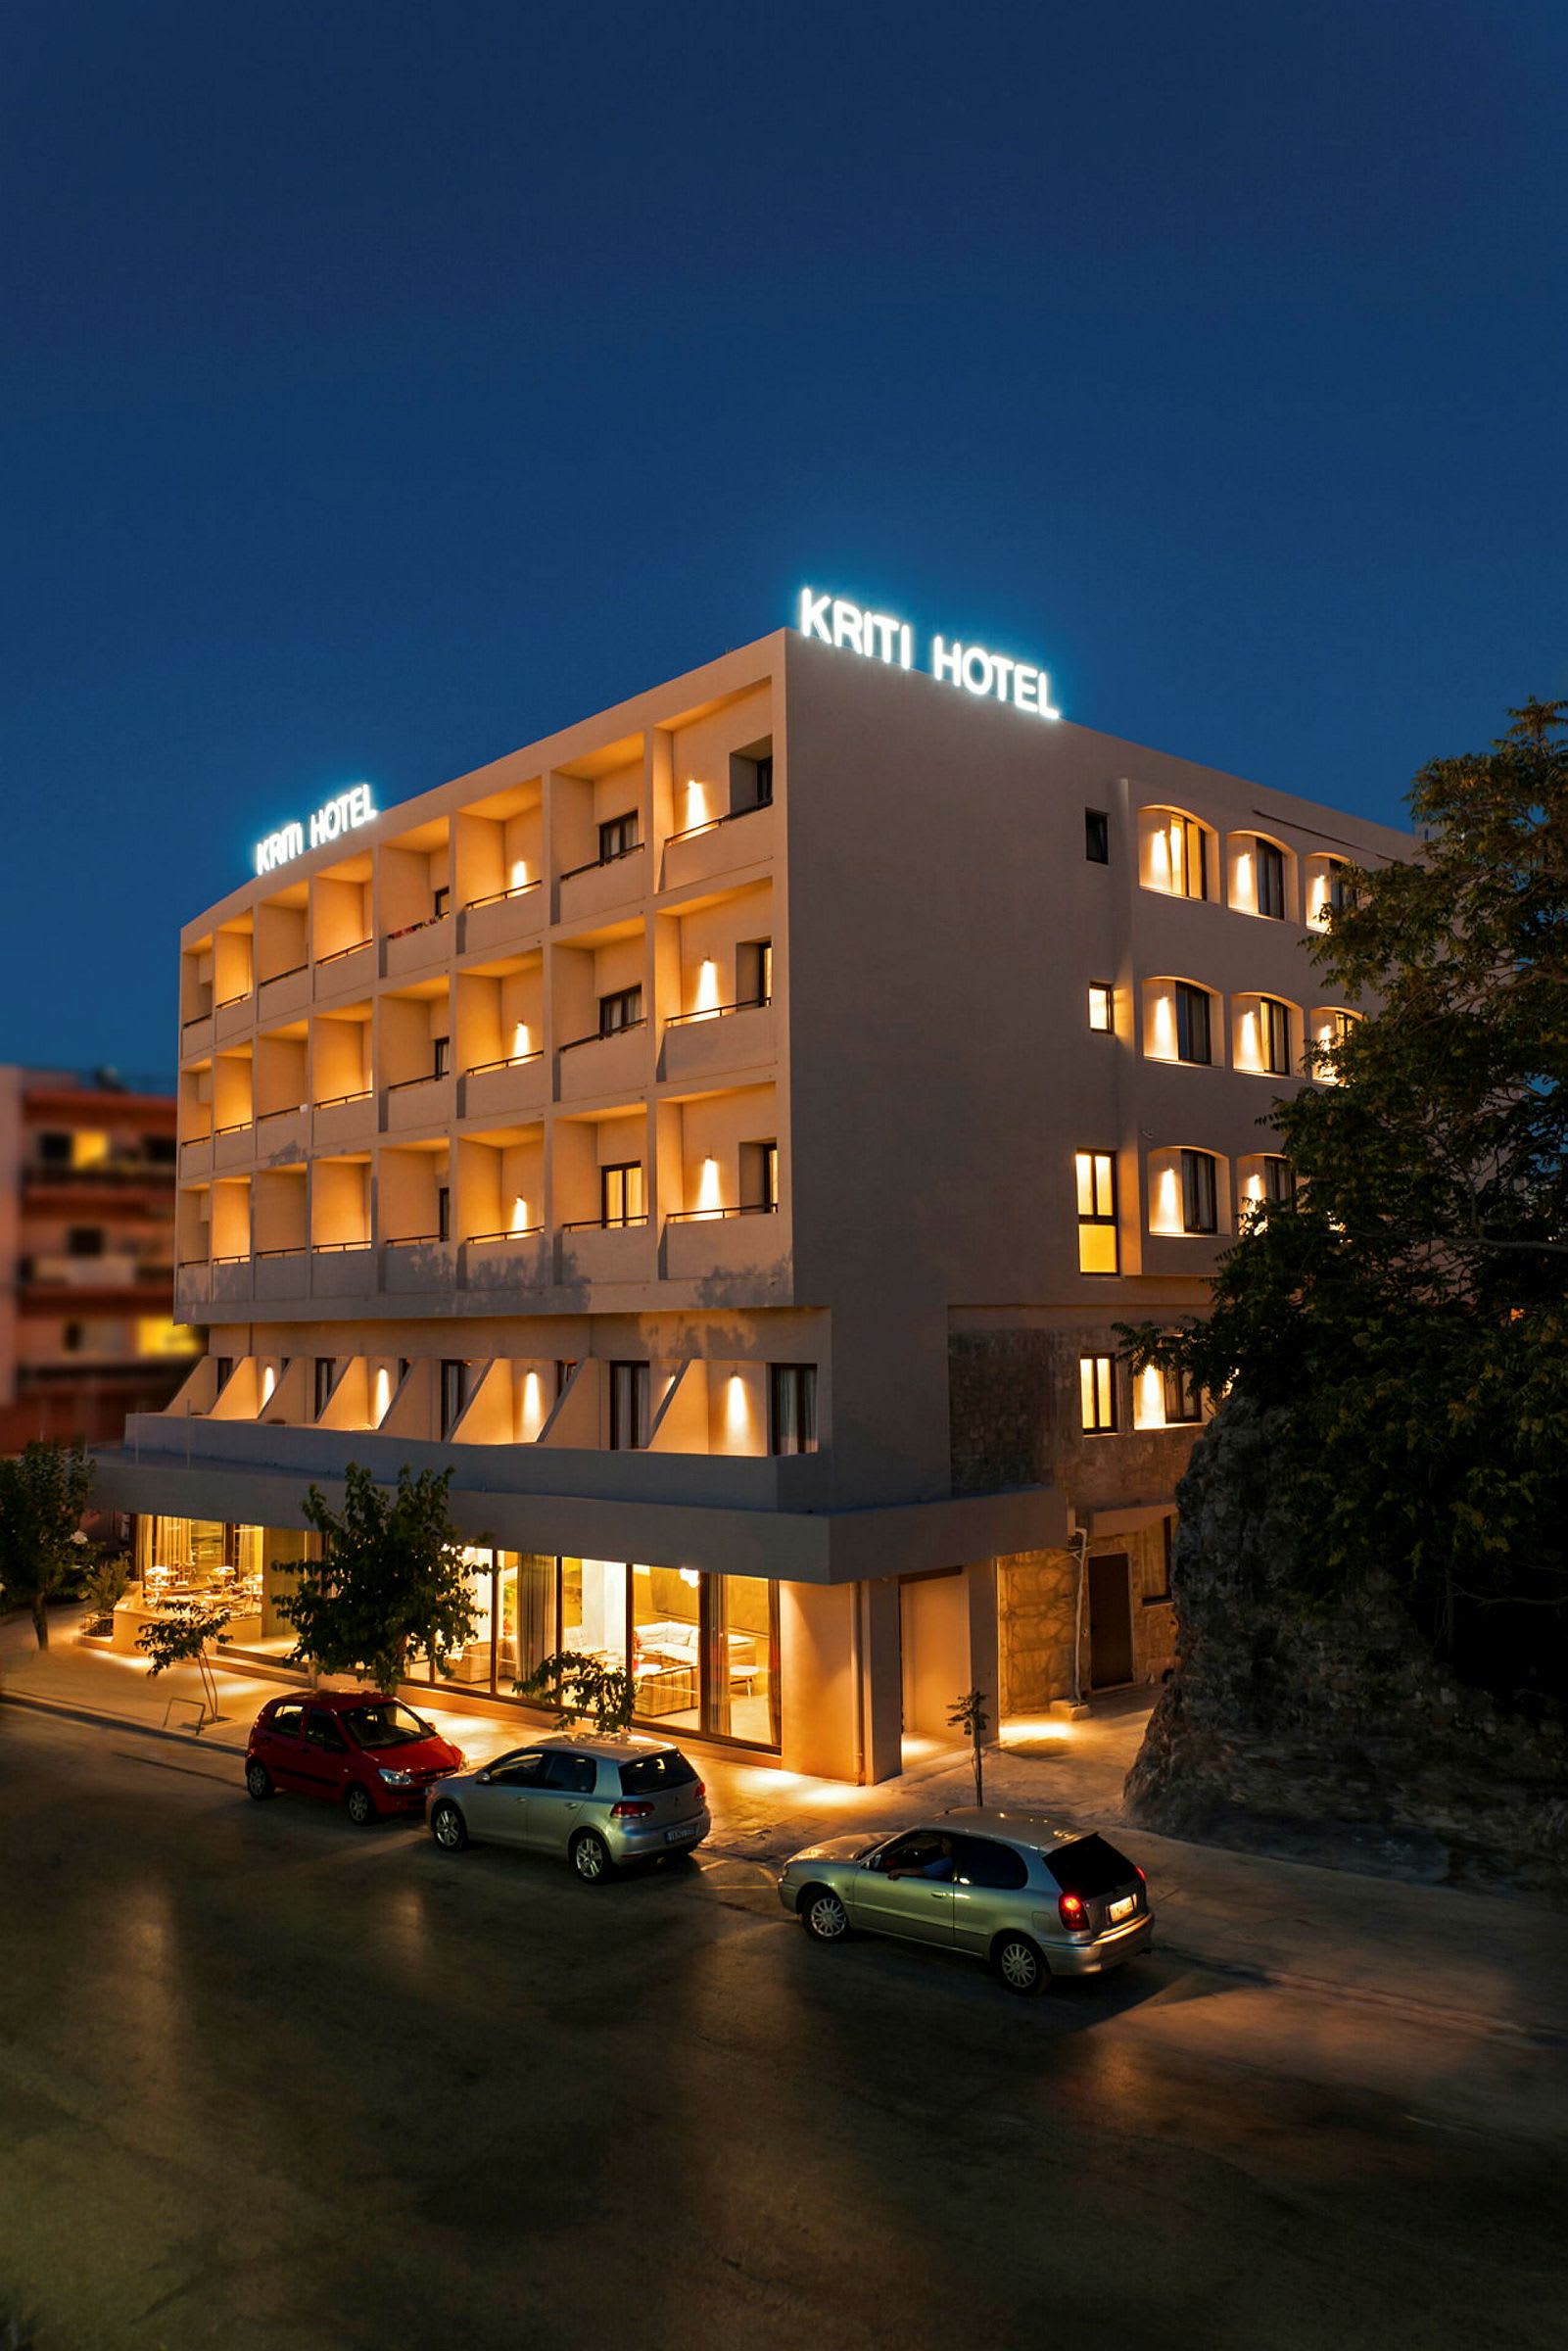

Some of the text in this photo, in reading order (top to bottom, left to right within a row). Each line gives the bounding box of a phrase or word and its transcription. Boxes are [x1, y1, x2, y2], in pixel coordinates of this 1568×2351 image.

[801, 588, 1061, 720] KRITI HOTEL
[256, 784, 377, 876] KRITI HOTEL
